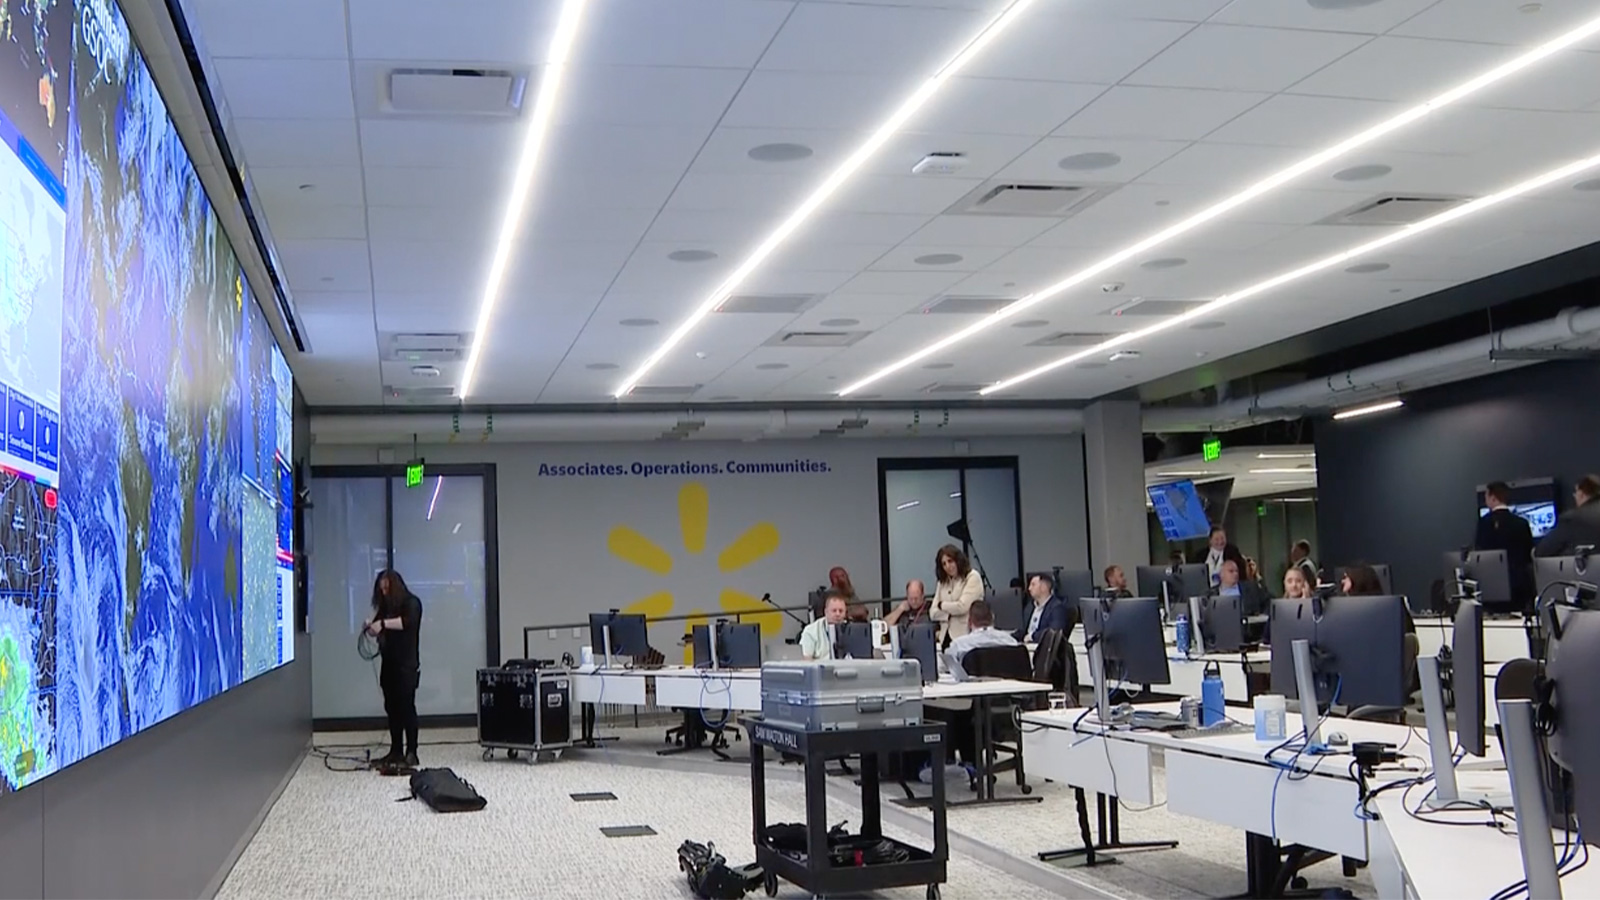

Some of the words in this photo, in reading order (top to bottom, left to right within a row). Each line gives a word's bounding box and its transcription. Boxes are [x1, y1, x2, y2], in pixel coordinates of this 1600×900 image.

[82, 5, 113, 84] GSOC
[90, 0, 124, 67] almart
[538, 462, 628, 476] Associates.
[631, 461, 723, 477] Operations.
[726, 460, 831, 474] Communities.
